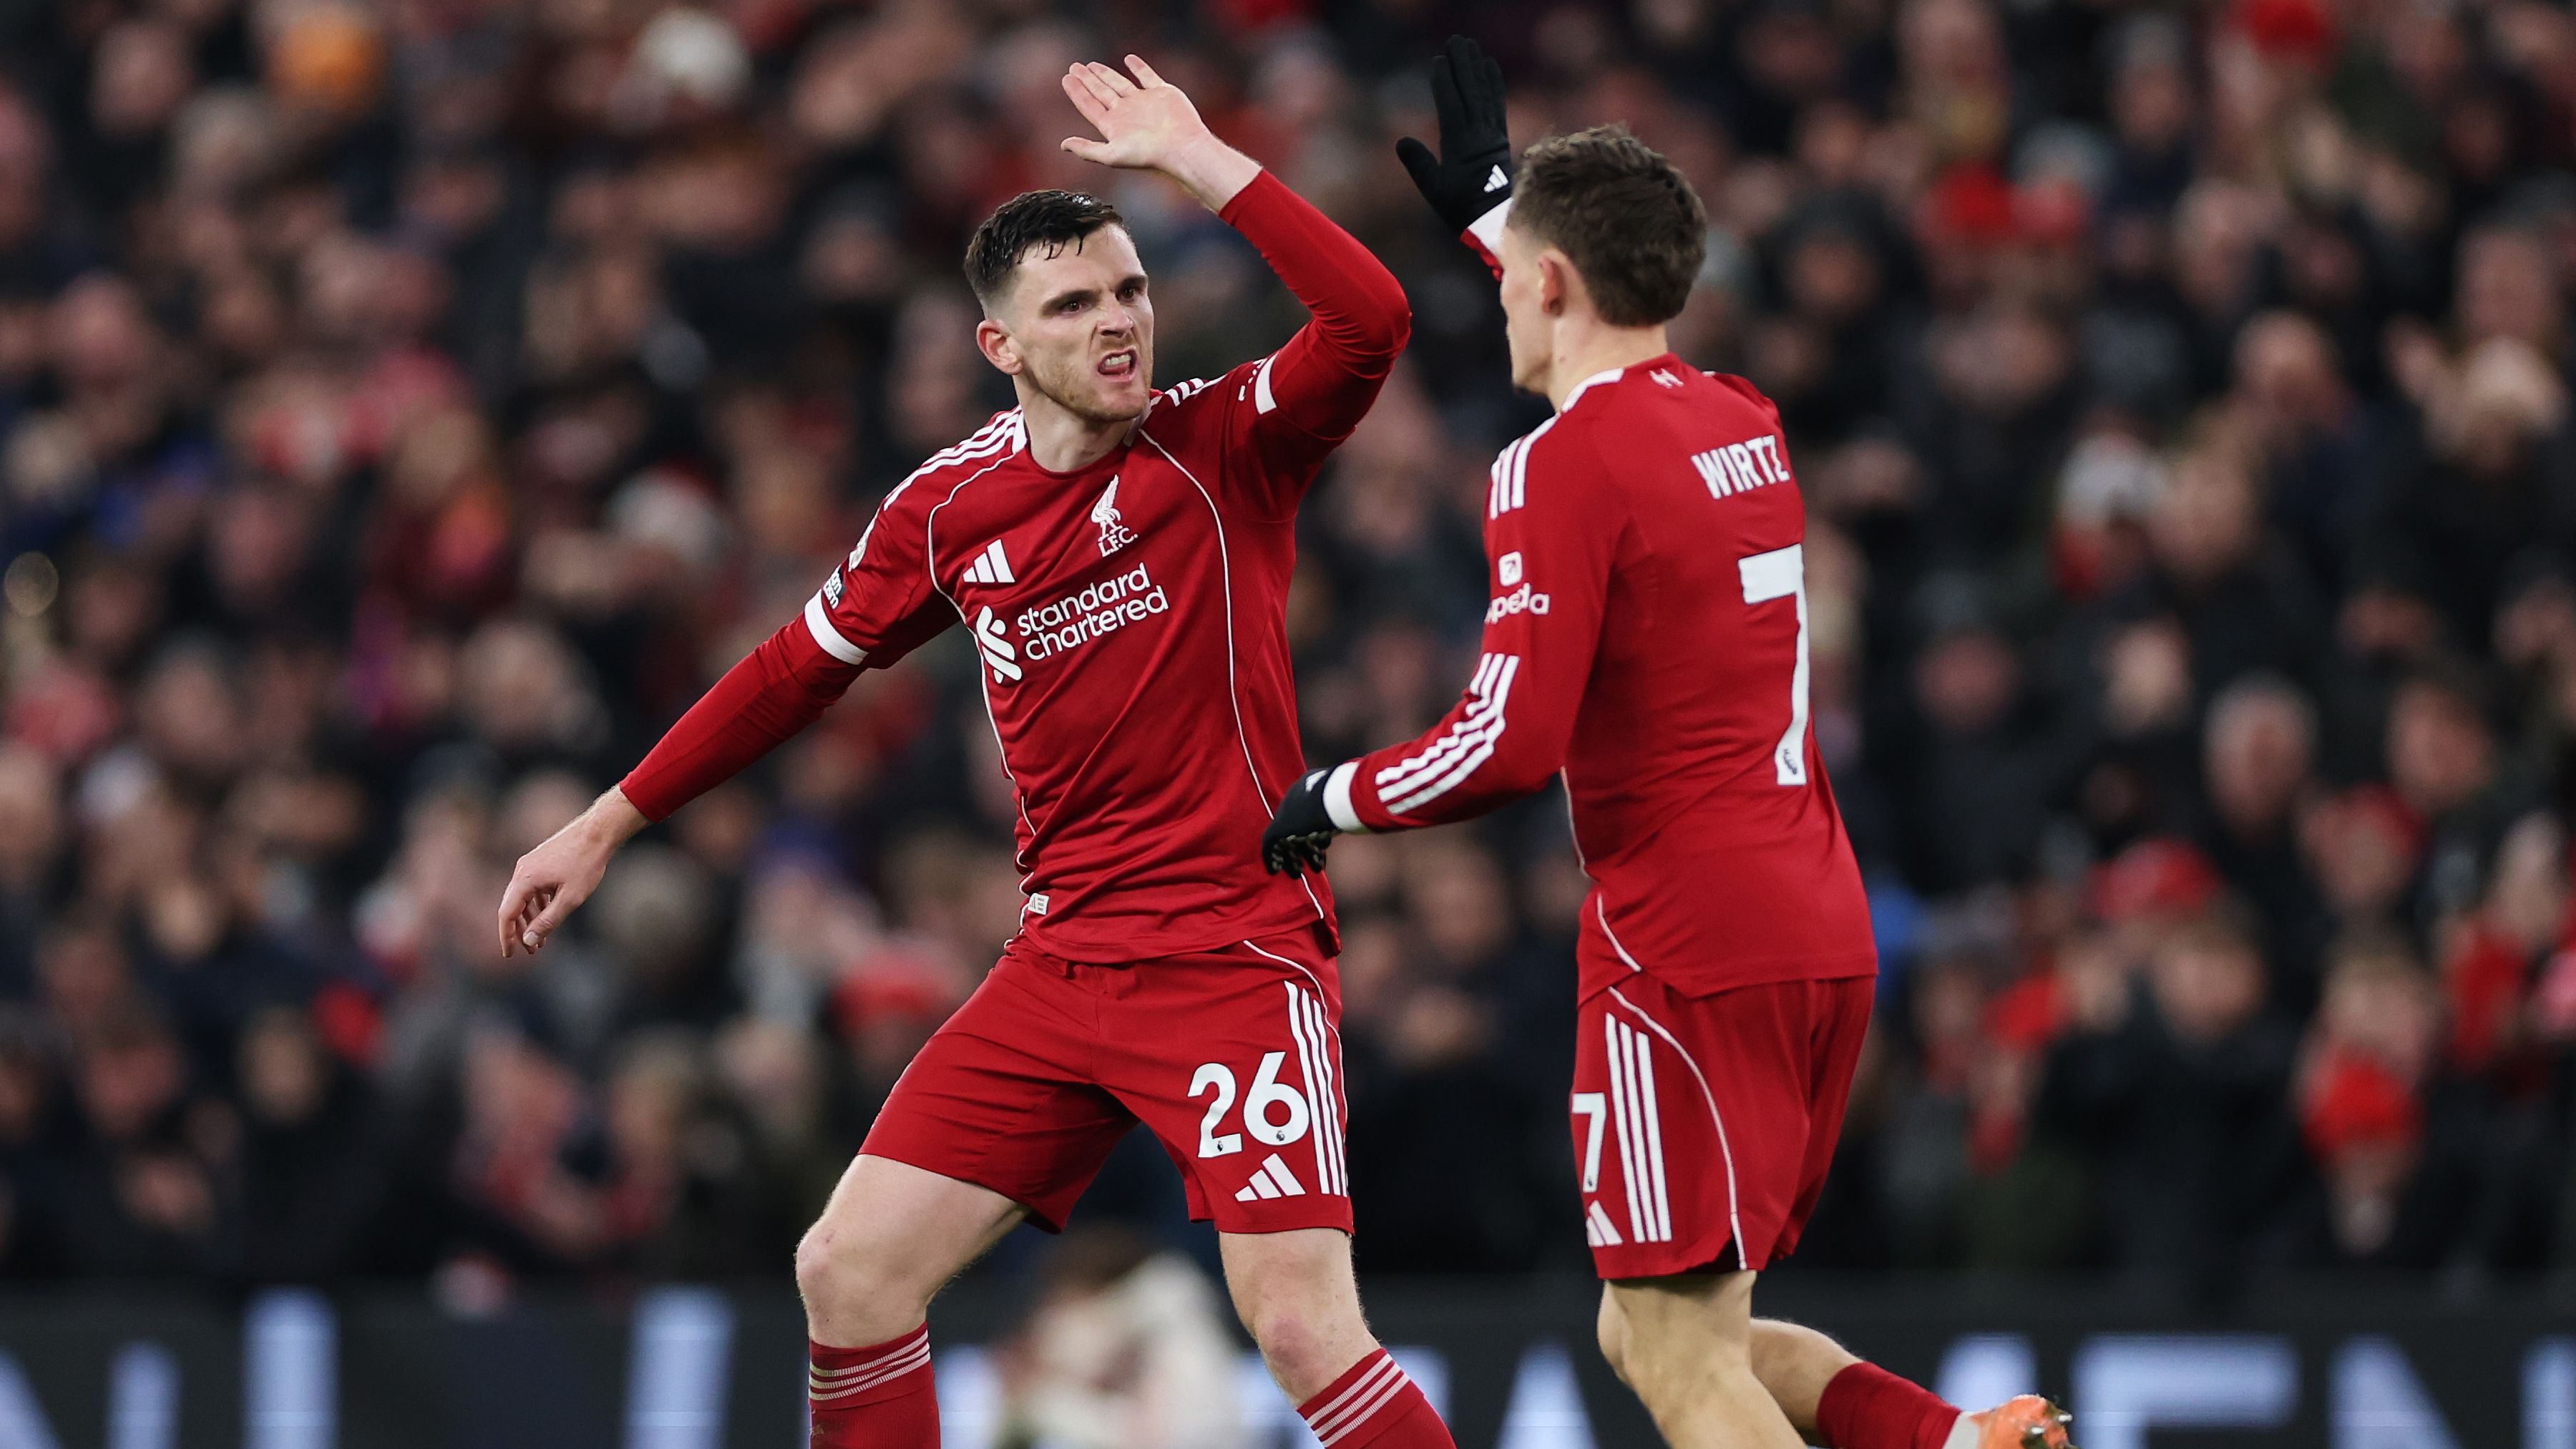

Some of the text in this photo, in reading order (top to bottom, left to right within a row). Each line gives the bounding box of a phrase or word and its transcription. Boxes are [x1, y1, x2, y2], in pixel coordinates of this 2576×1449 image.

[1691, 434, 1790, 499] WIRTZ
[1018, 562, 1151, 637] standard
[1025, 585, 1169, 660] chartered
[1737, 542, 1810, 786] 7
[1187, 1051, 1310, 1158] 26
[1571, 1092, 1607, 1194] 7
